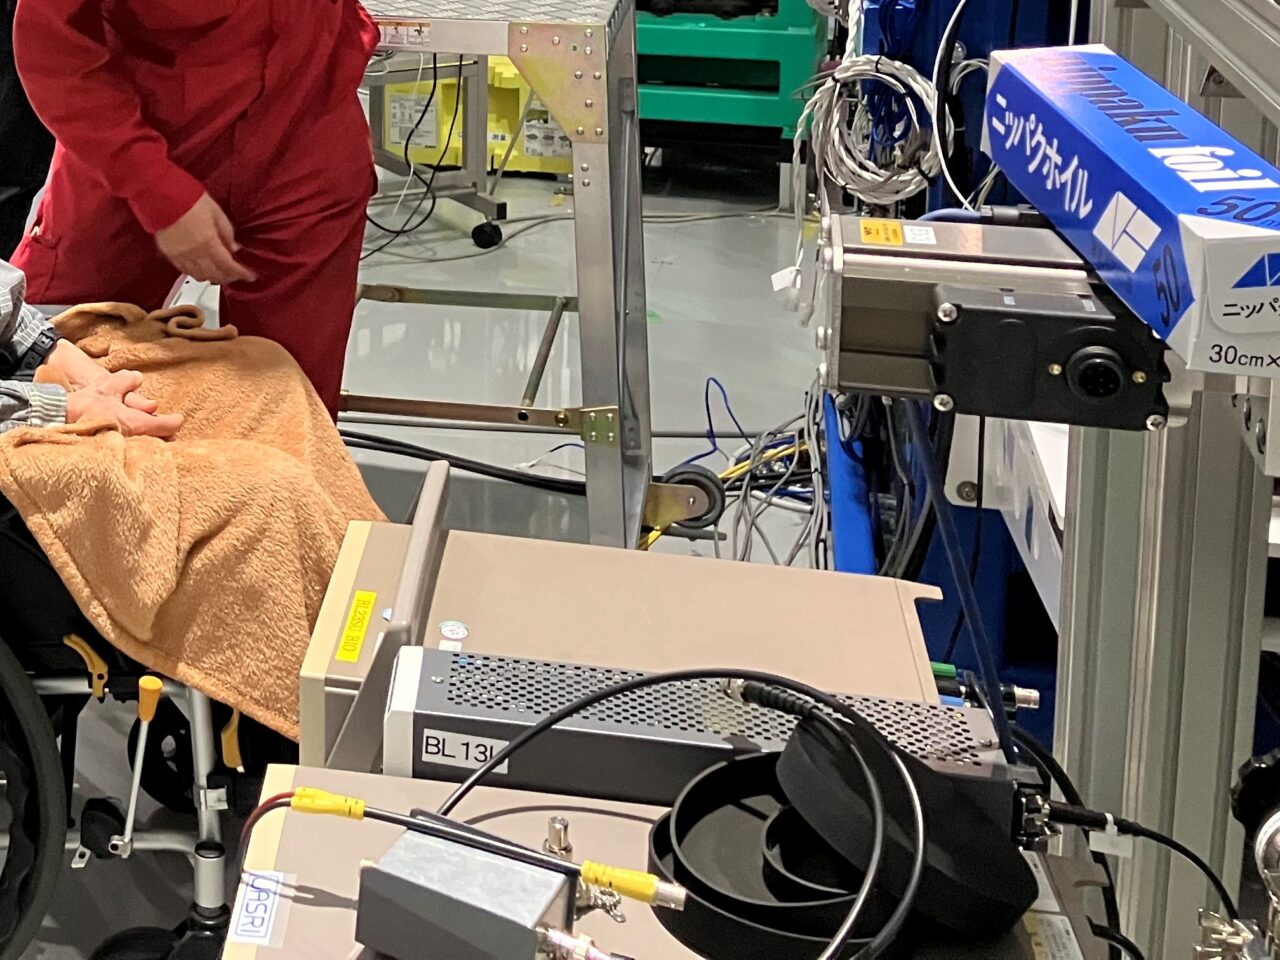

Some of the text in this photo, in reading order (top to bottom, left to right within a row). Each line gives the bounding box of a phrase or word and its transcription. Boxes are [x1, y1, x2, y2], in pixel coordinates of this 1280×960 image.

[991, 92, 1094, 220] ニッパクホイル
[1146, 146, 1280, 193] foil
[1222, 296, 1280, 319] ニッパ
[424, 735, 457, 759] BL
